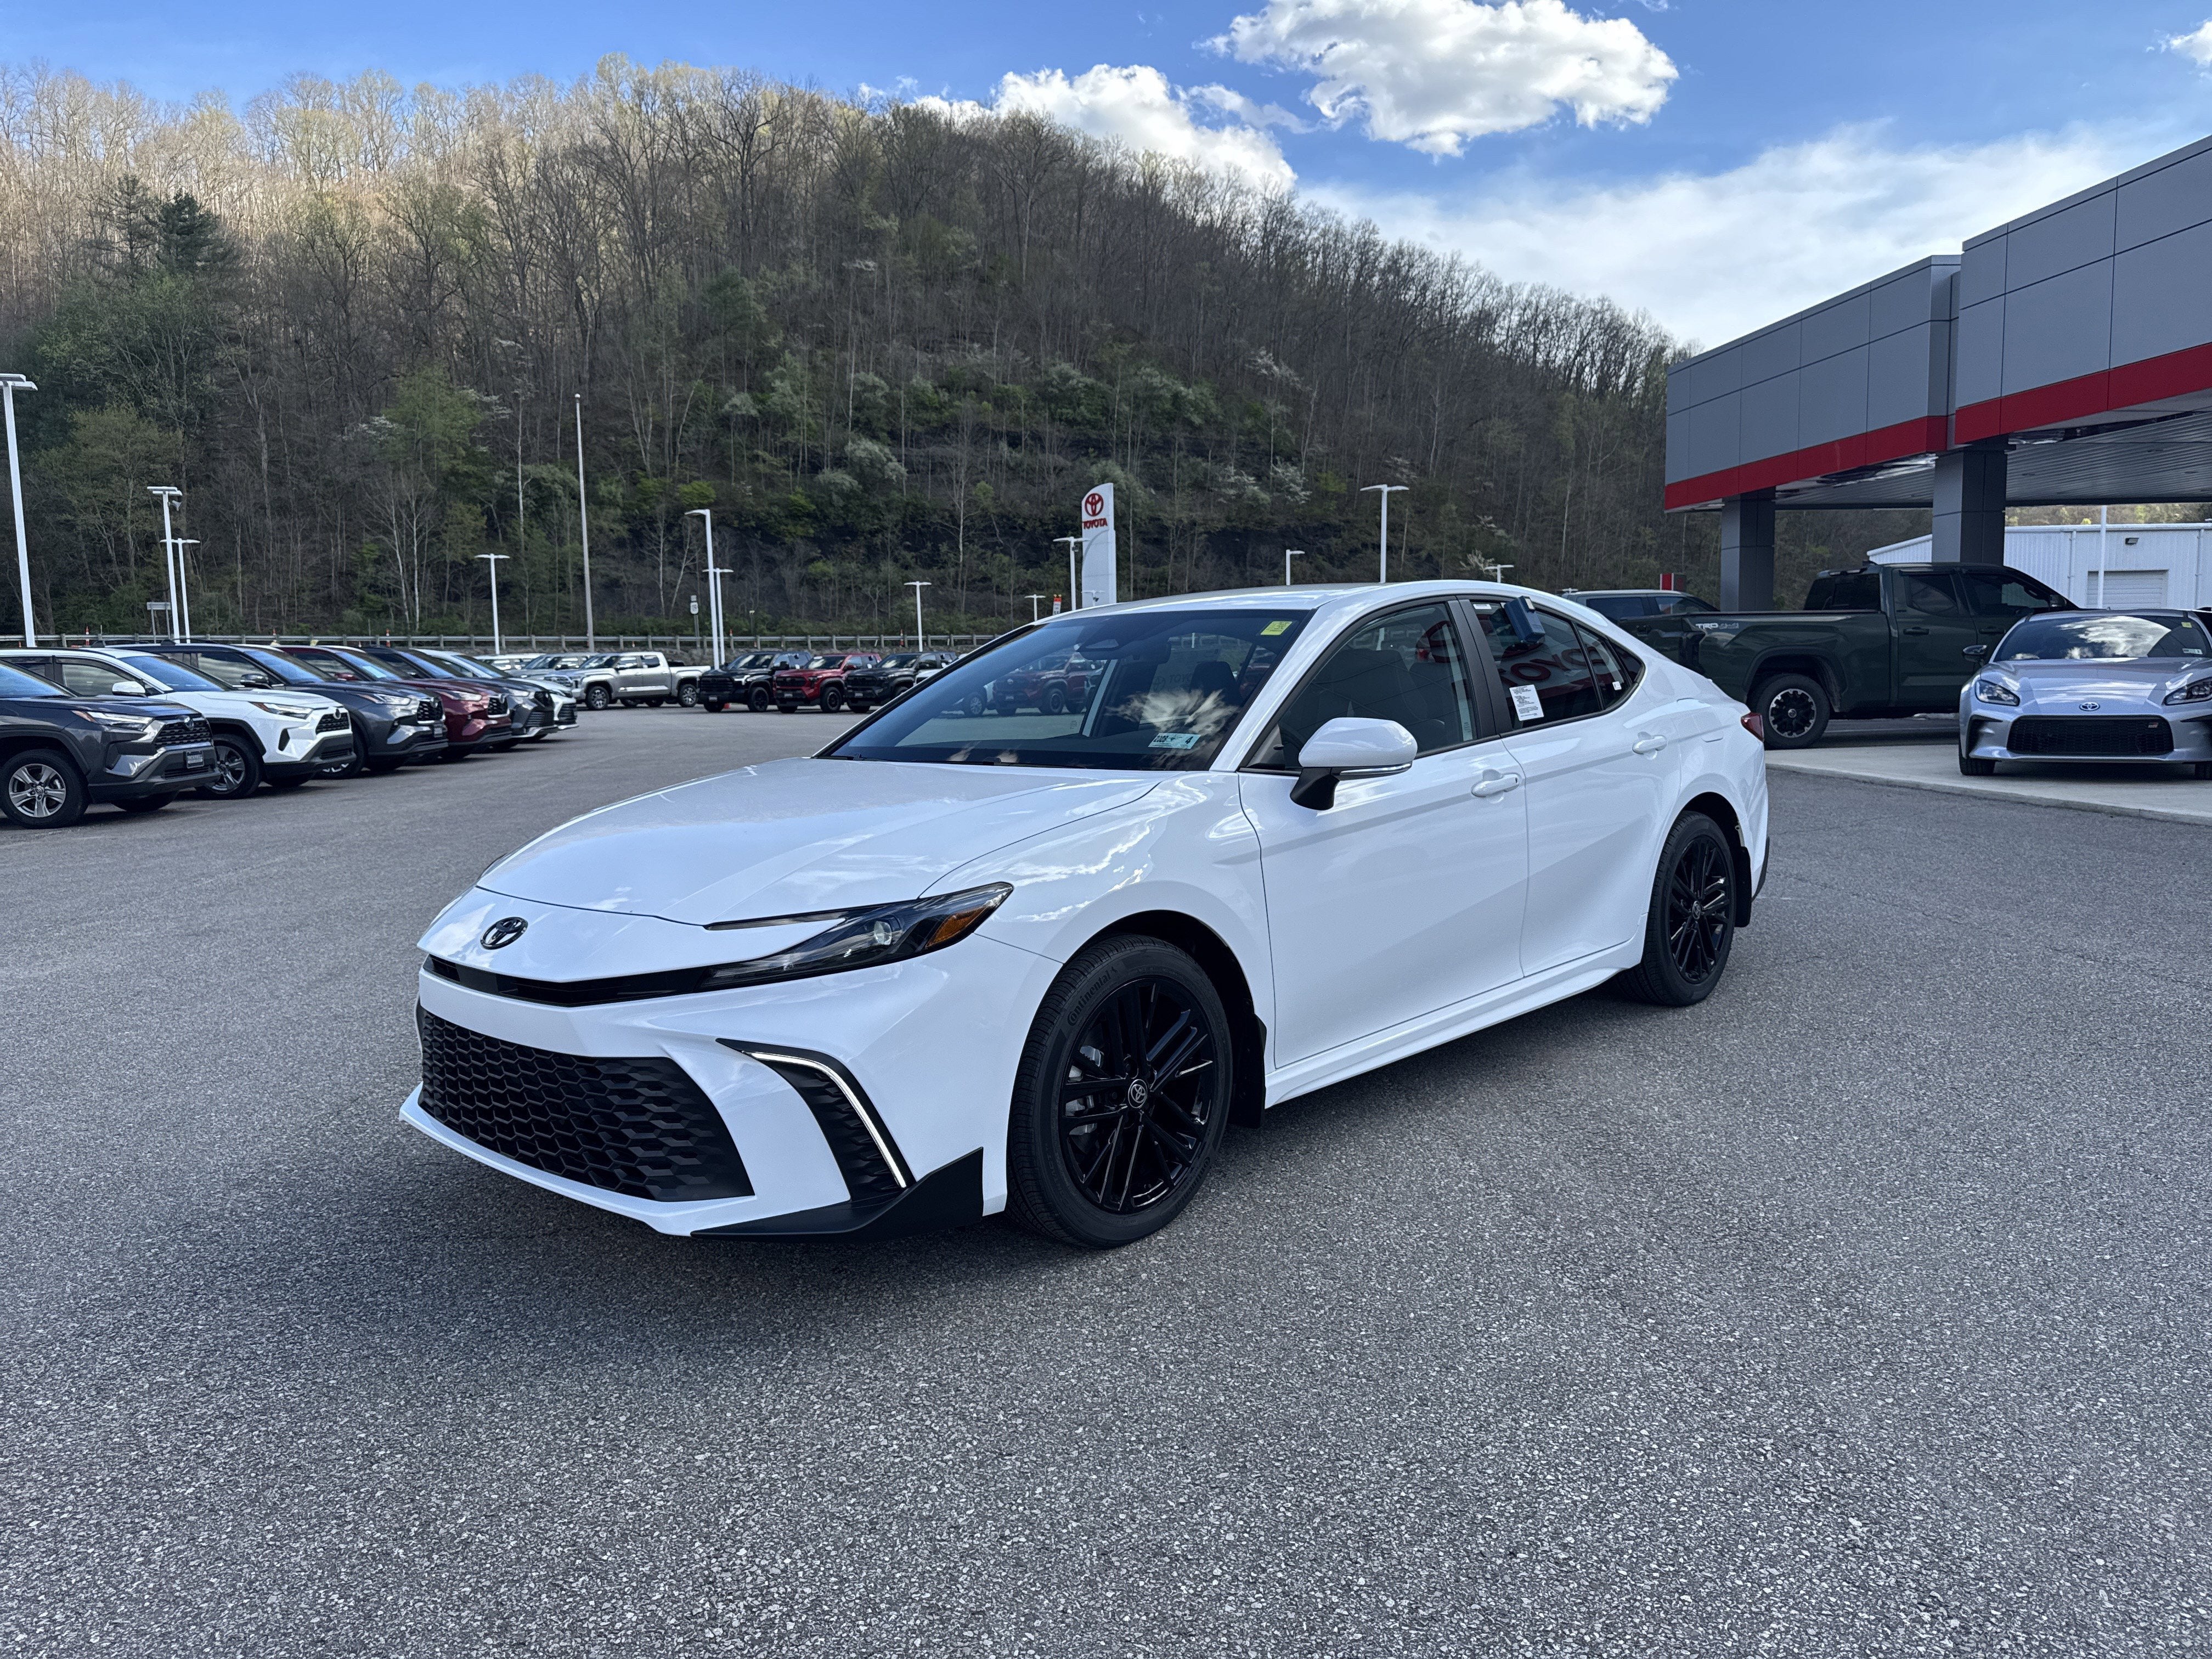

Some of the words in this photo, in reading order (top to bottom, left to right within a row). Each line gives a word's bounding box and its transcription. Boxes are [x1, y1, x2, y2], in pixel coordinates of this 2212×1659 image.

[1082, 518, 1108, 530] TOYOTA
[1185, 736, 1194, 744] 4
[1068, 969, 1111, 1026] Continental
